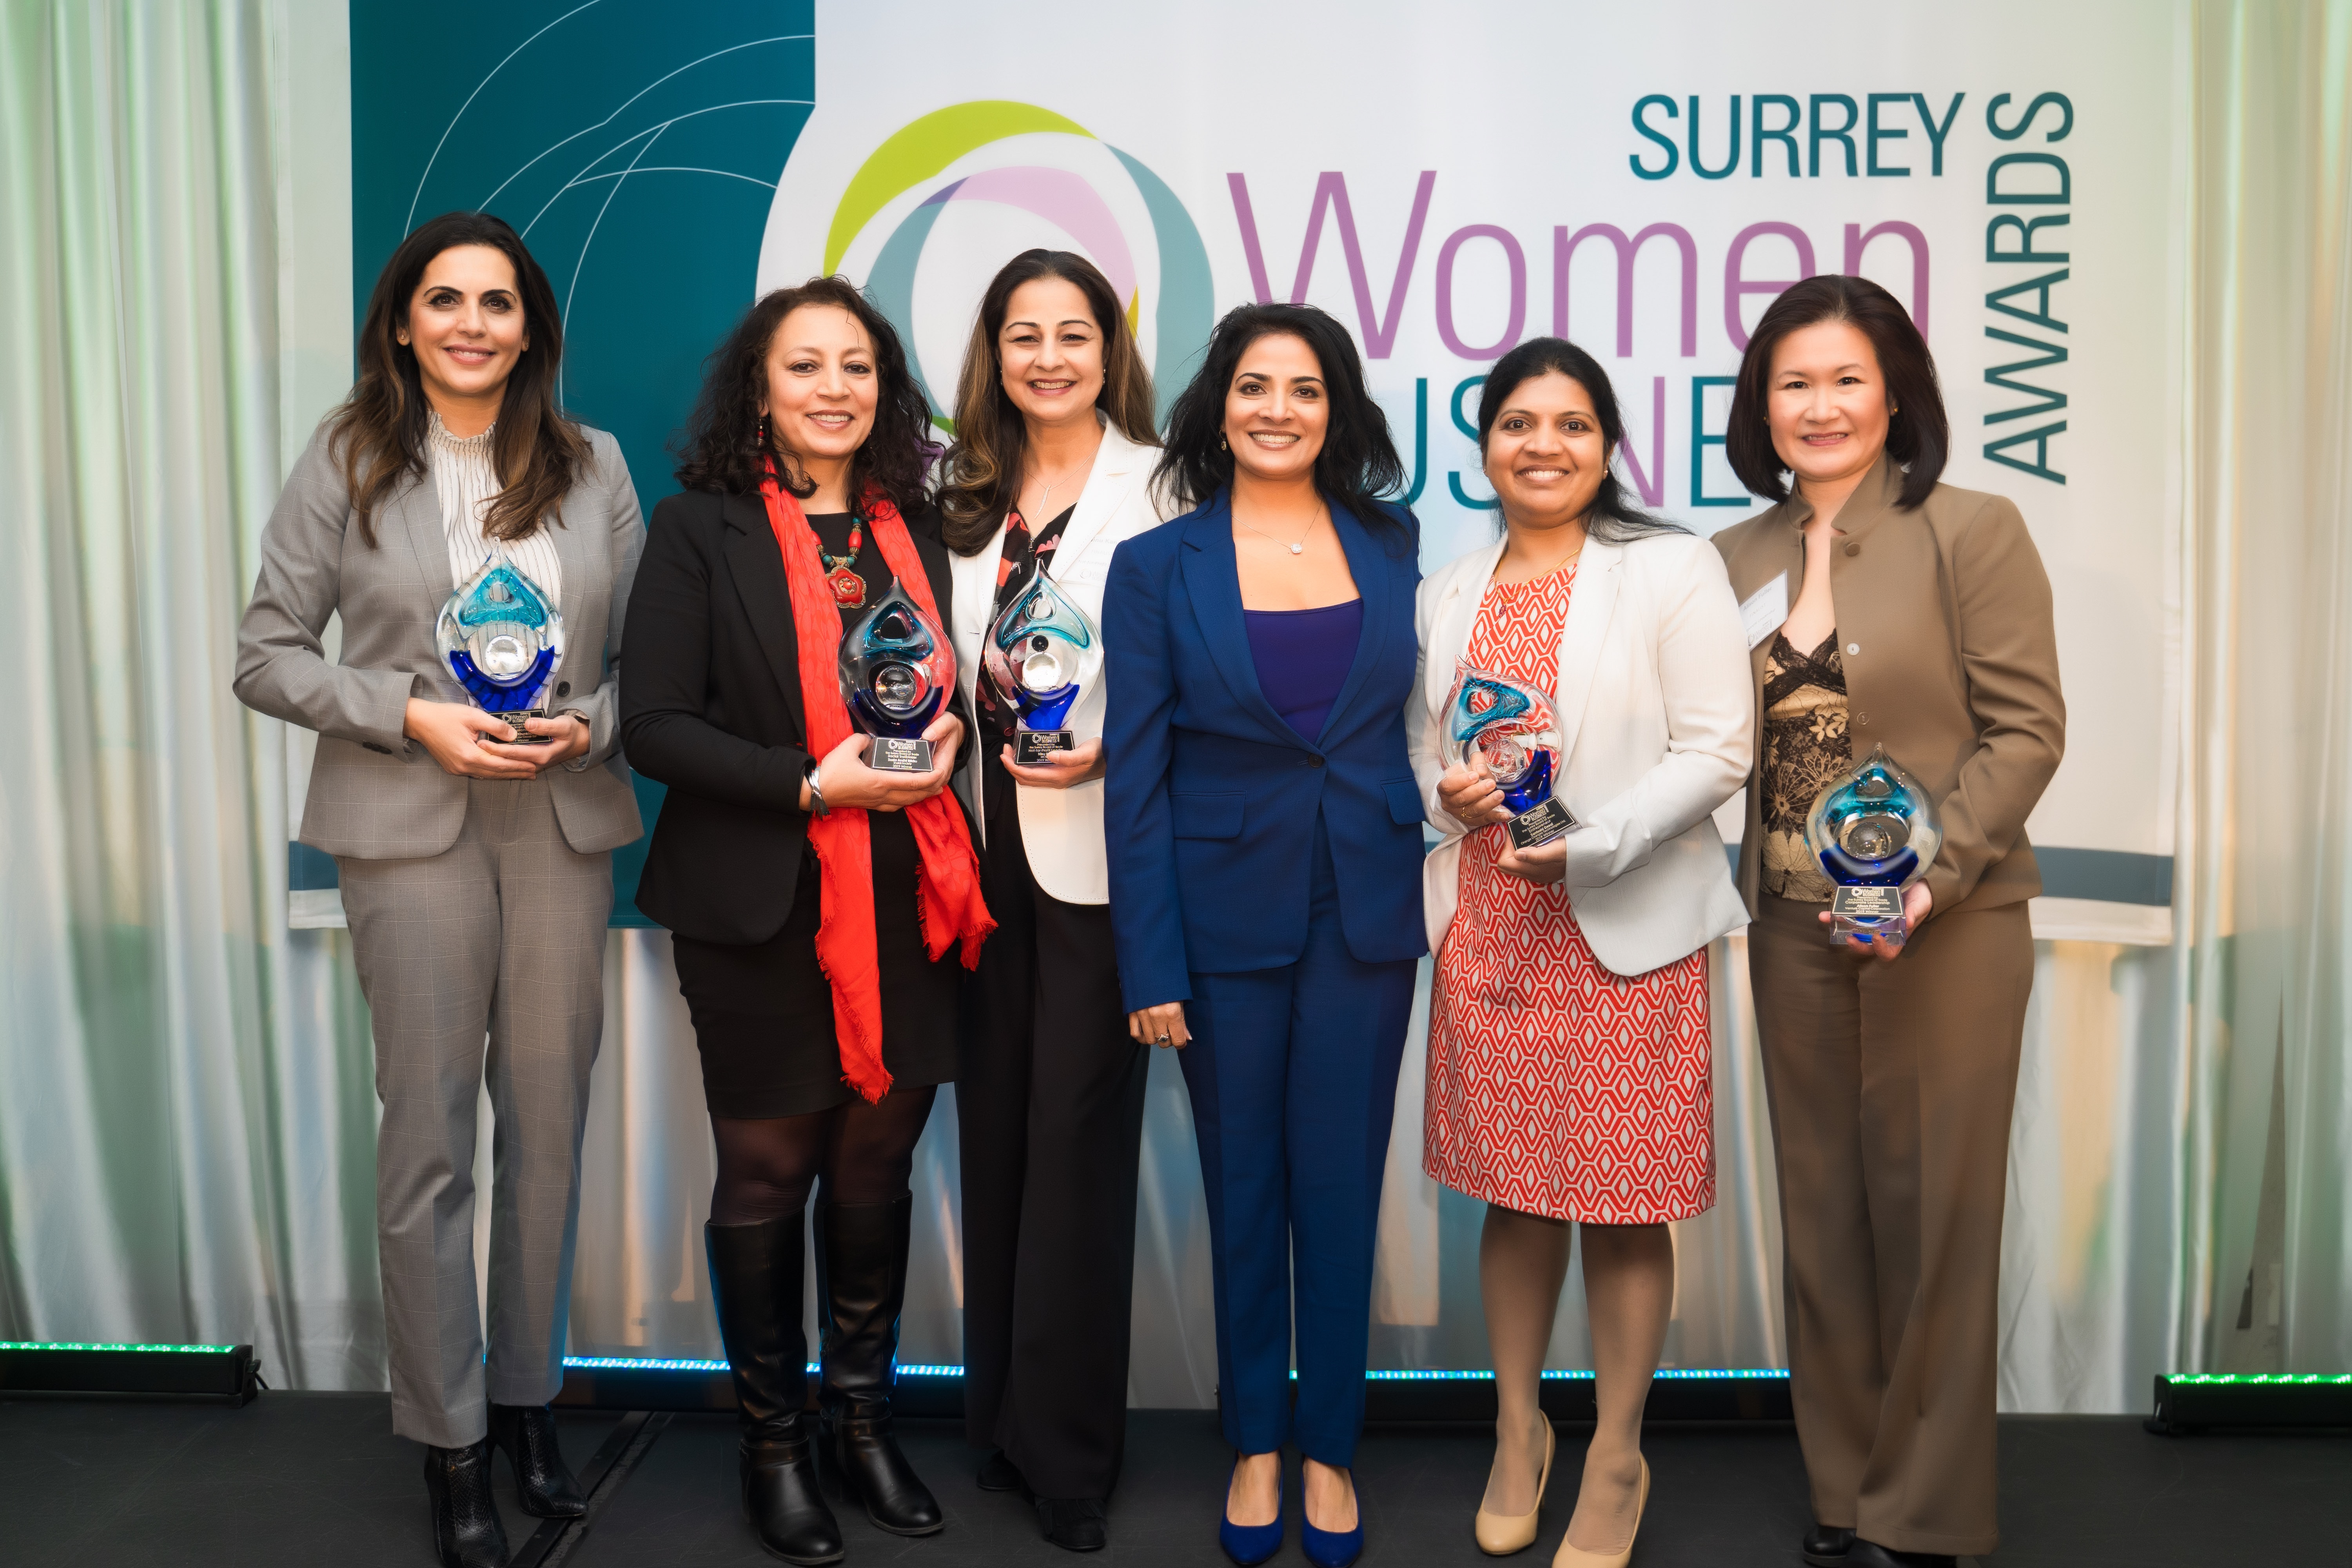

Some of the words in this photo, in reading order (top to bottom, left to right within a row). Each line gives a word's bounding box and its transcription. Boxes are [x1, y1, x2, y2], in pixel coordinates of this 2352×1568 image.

[1629, 93, 1965, 181] SURREY
[1226, 170, 1930, 361] Women
[1984, 92, 2073, 484] AWARDS
[1759, 587, 1772, 599] Fuller
[1528, 808, 1546, 818] Women
[1531, 812, 1546, 821] BUSINESS
[1528, 817, 1542, 826] Presented
[1528, 819, 1551, 833] Entrepreneur
[1543, 822, 1561, 833] Technologies
